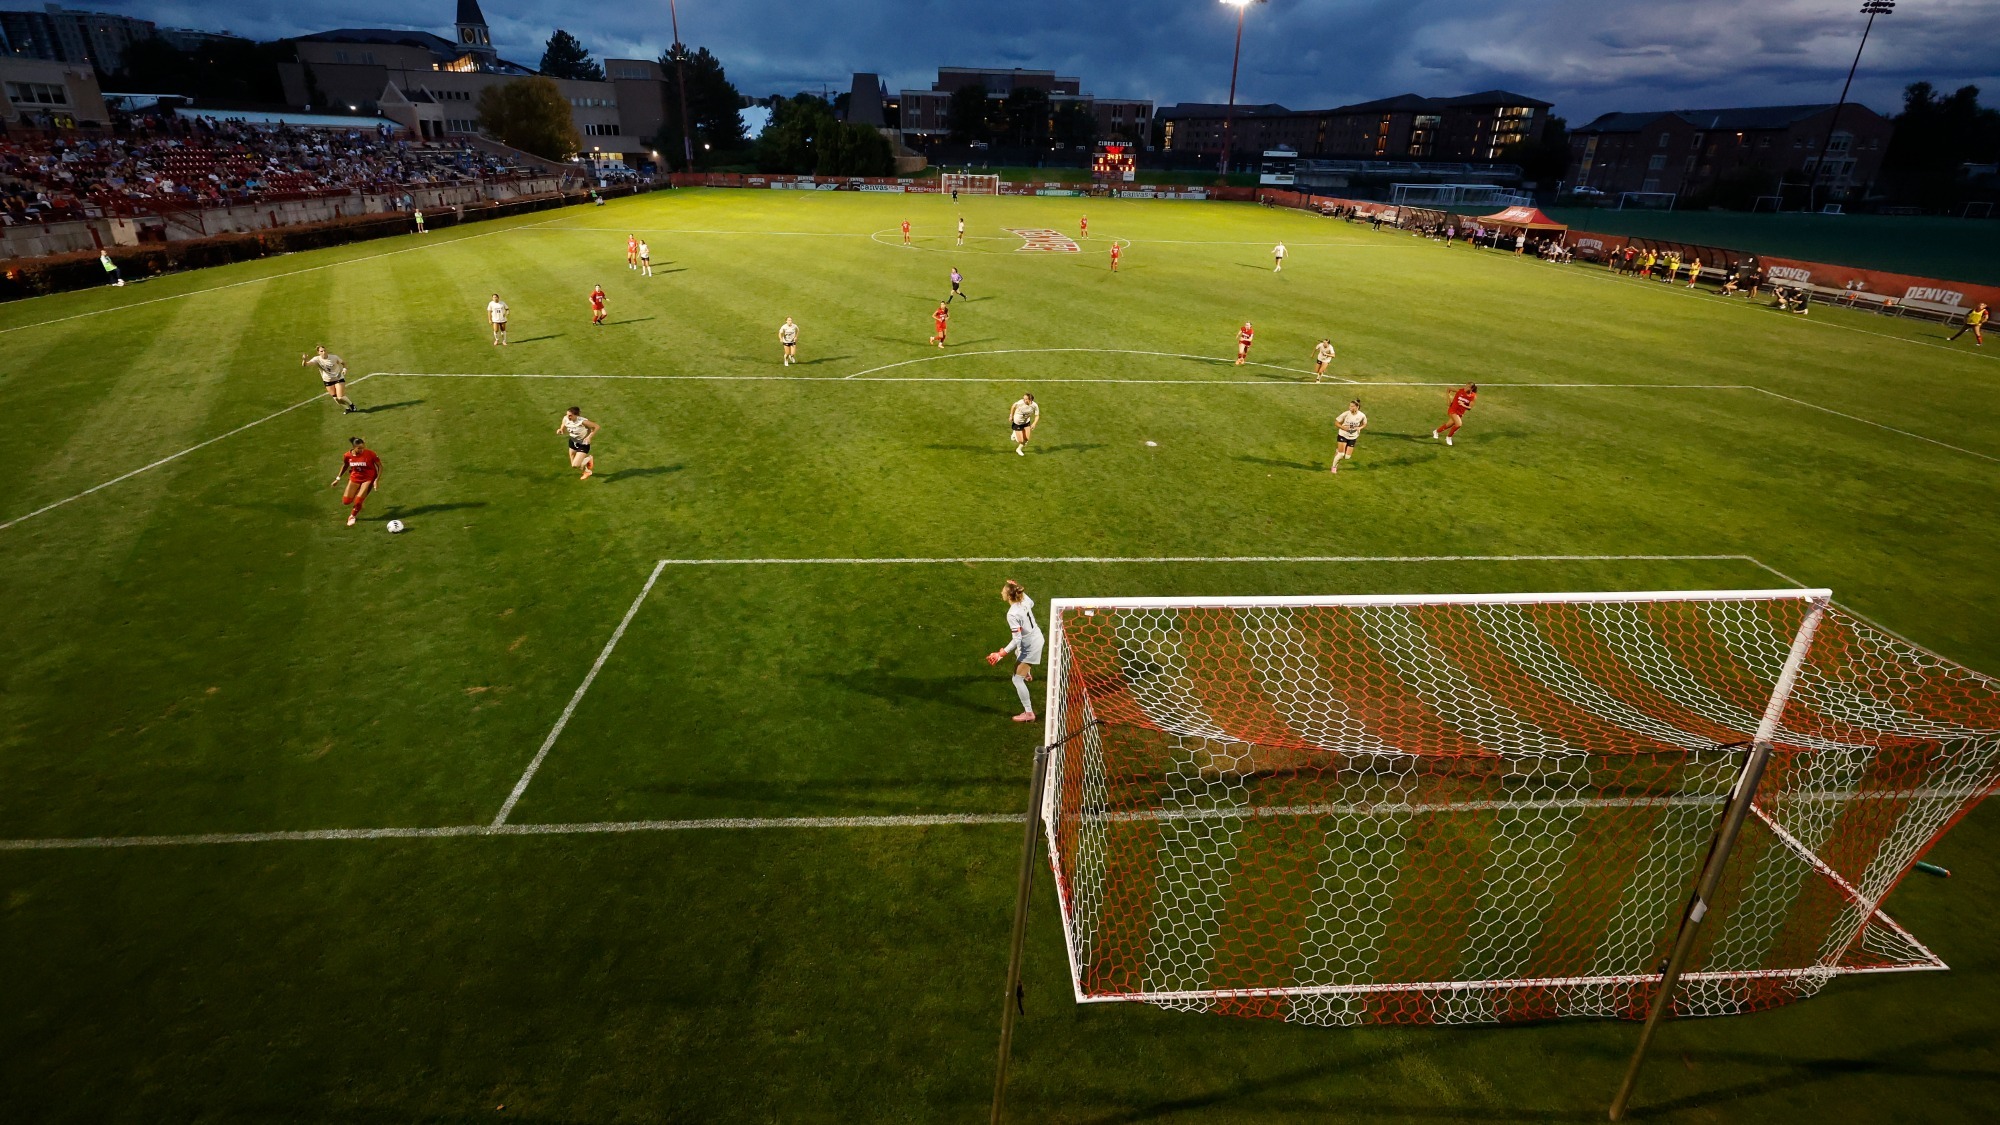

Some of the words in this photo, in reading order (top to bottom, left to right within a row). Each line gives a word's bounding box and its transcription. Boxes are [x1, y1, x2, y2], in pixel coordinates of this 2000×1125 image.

[1577, 238, 1603, 251] DENVER
[1767, 266, 1811, 283] DENVER
[1904, 286, 1963, 307] DENVER
[1026, 611, 1034, 629] 1
